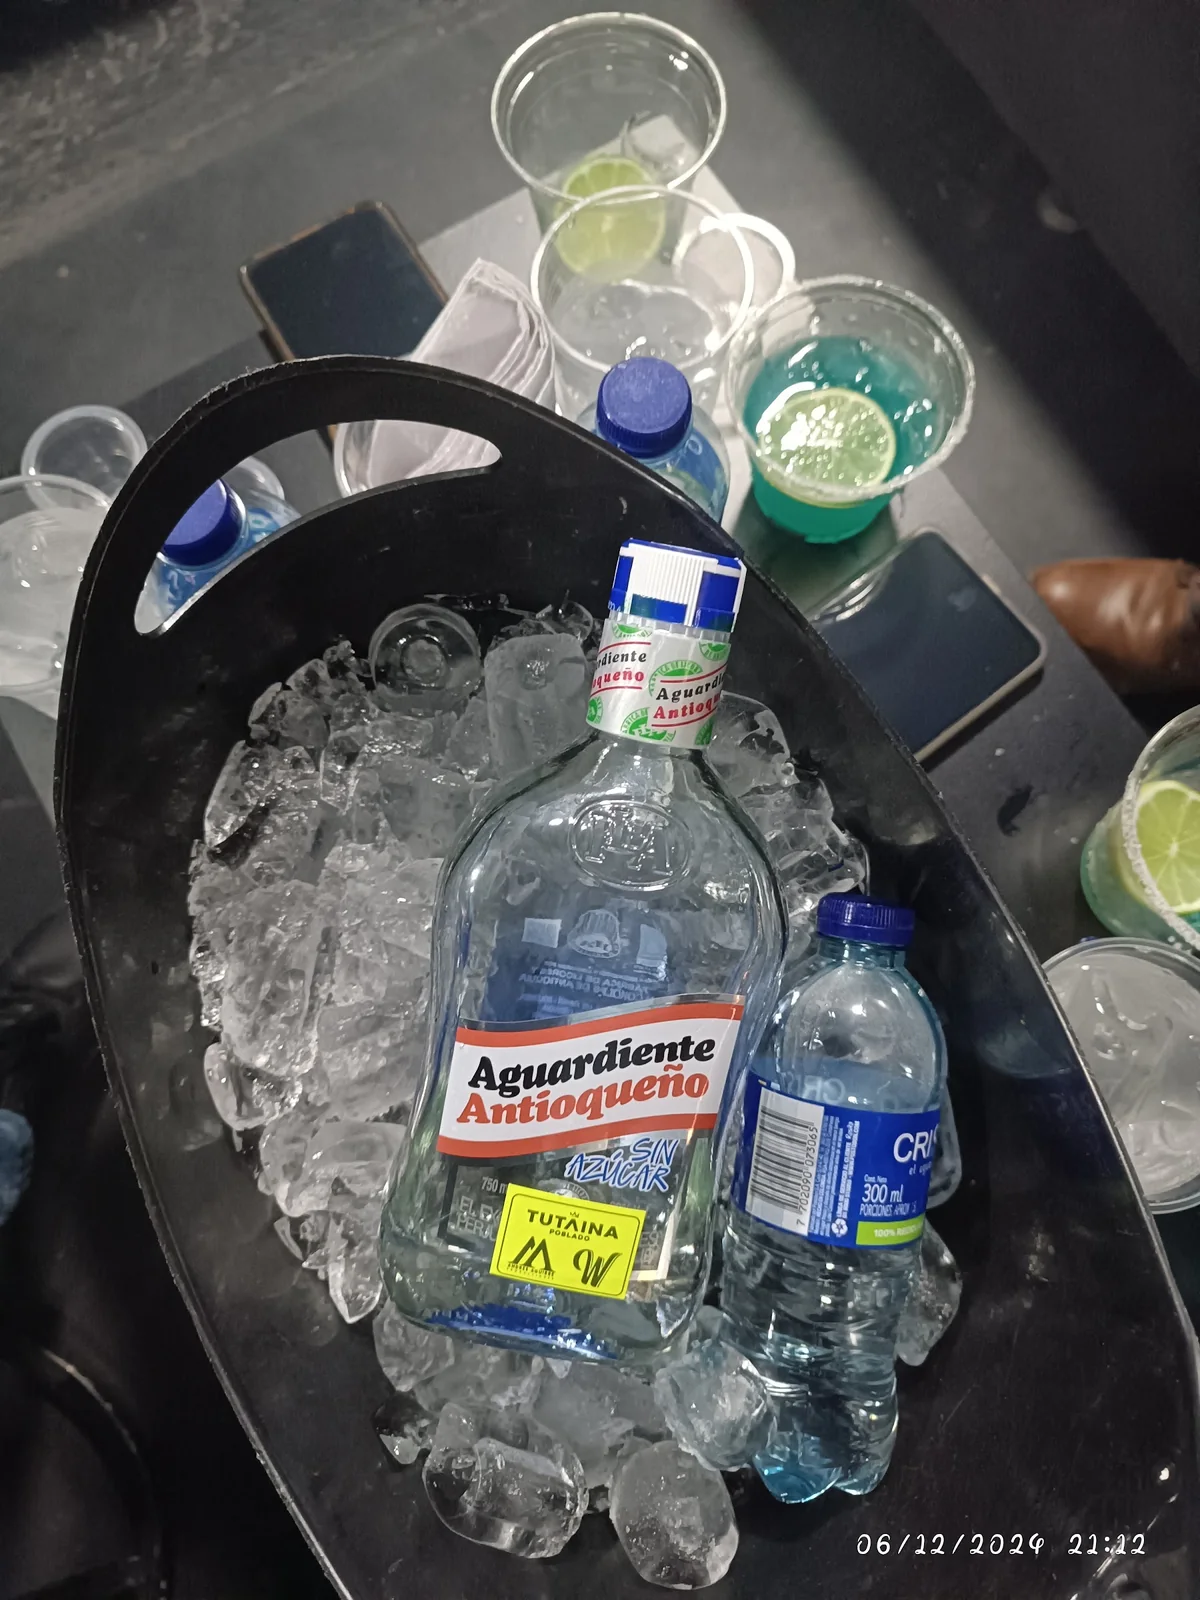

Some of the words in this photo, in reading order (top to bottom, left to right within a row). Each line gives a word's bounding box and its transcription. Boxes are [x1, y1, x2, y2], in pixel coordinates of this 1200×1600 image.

[468, 1035, 716, 1098] Aguardiente
[456, 1064, 709, 1124] Antioqueño
[629, 1137, 679, 1166] SIN
[804, 1126, 818, 1168] 073065
[481, 1176, 498, 1192] 750
[499, 1182, 506, 1194] m
[564, 1150, 671, 1192] AZÚCAR
[800, 1170, 814, 1213] 702090
[862, 1183, 888, 1203] 300
[890, 1184, 904, 1203] ml
[528, 1209, 618, 1239] TUTAINA
[549, 1228, 590, 1241] POBLADO
